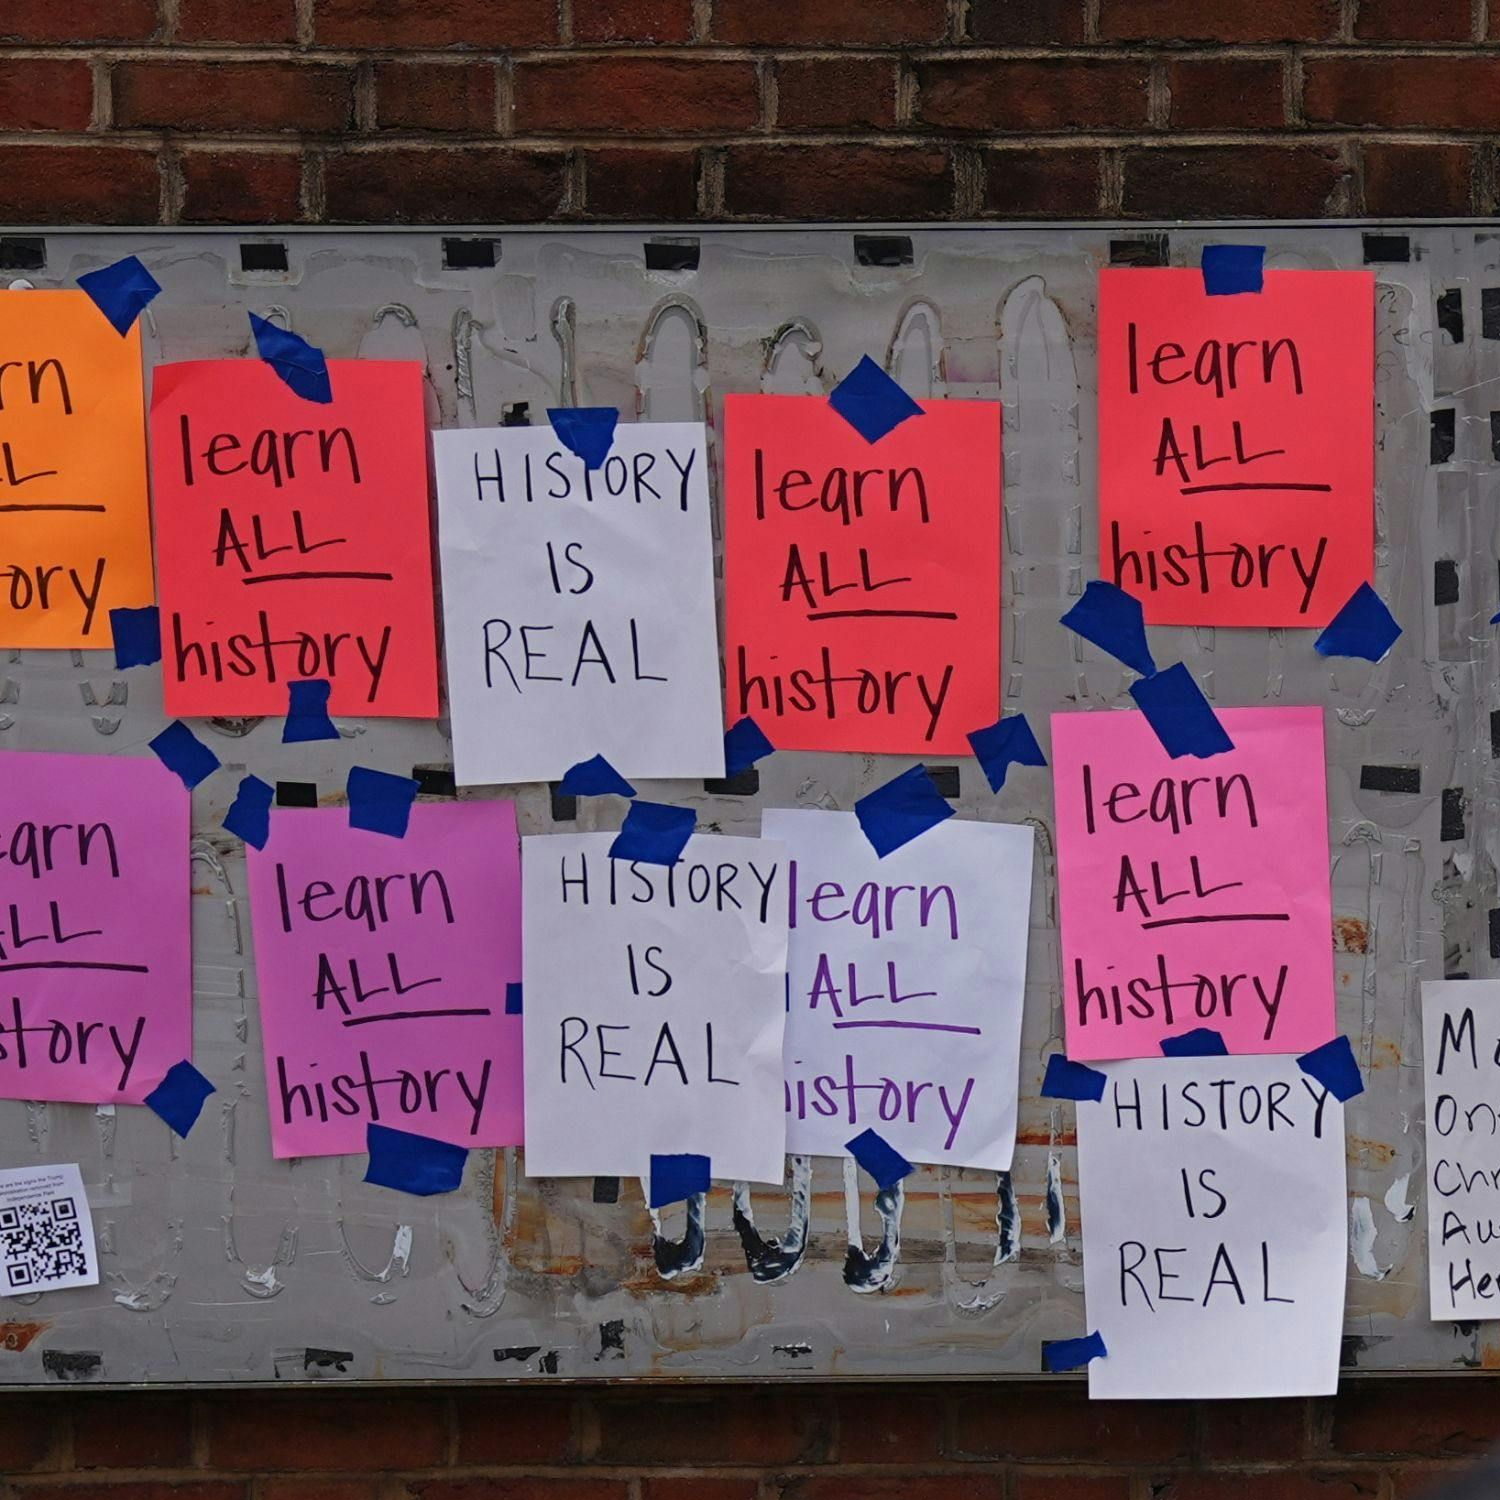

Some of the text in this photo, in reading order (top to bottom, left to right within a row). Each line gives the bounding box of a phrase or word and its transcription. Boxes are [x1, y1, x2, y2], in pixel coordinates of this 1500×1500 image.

[1128, 323, 1303, 398] learn
[180, 416, 361, 486] learn
[1153, 417, 1285, 483] ALL
[755, 449, 929, 525] learn
[215, 509, 346, 571] ALL
[548, 542, 593, 594] IS
[1111, 522, 1326, 613] history
[0, 558, 105, 635] ory
[779, 544, 911, 608] ALL
[173, 611, 391, 702] history
[483, 619, 668, 693] REAL
[738, 647, 953, 741] history
[1083, 765, 1257, 833] learn
[0, 822, 119, 878] arn
[276, 864, 454, 932] learn
[561, 854, 777, 923] HISTORY
[789, 860, 957, 939] learn
[1114, 855, 1242, 917] ALL
[0, 901, 102, 960] LL
[313, 952, 441, 1015] ALL
[627, 946, 672, 996] IS
[809, 953, 937, 1016] ALL
[1075, 954, 1288, 1040] history
[560, 1017, 740, 1088] REAL
[277, 1052, 491, 1135] history
[1115, 1079, 1327, 1138] HISTORY
[1181, 1168, 1227, 1219] IS
[1120, 1242, 1294, 1311] REAL
